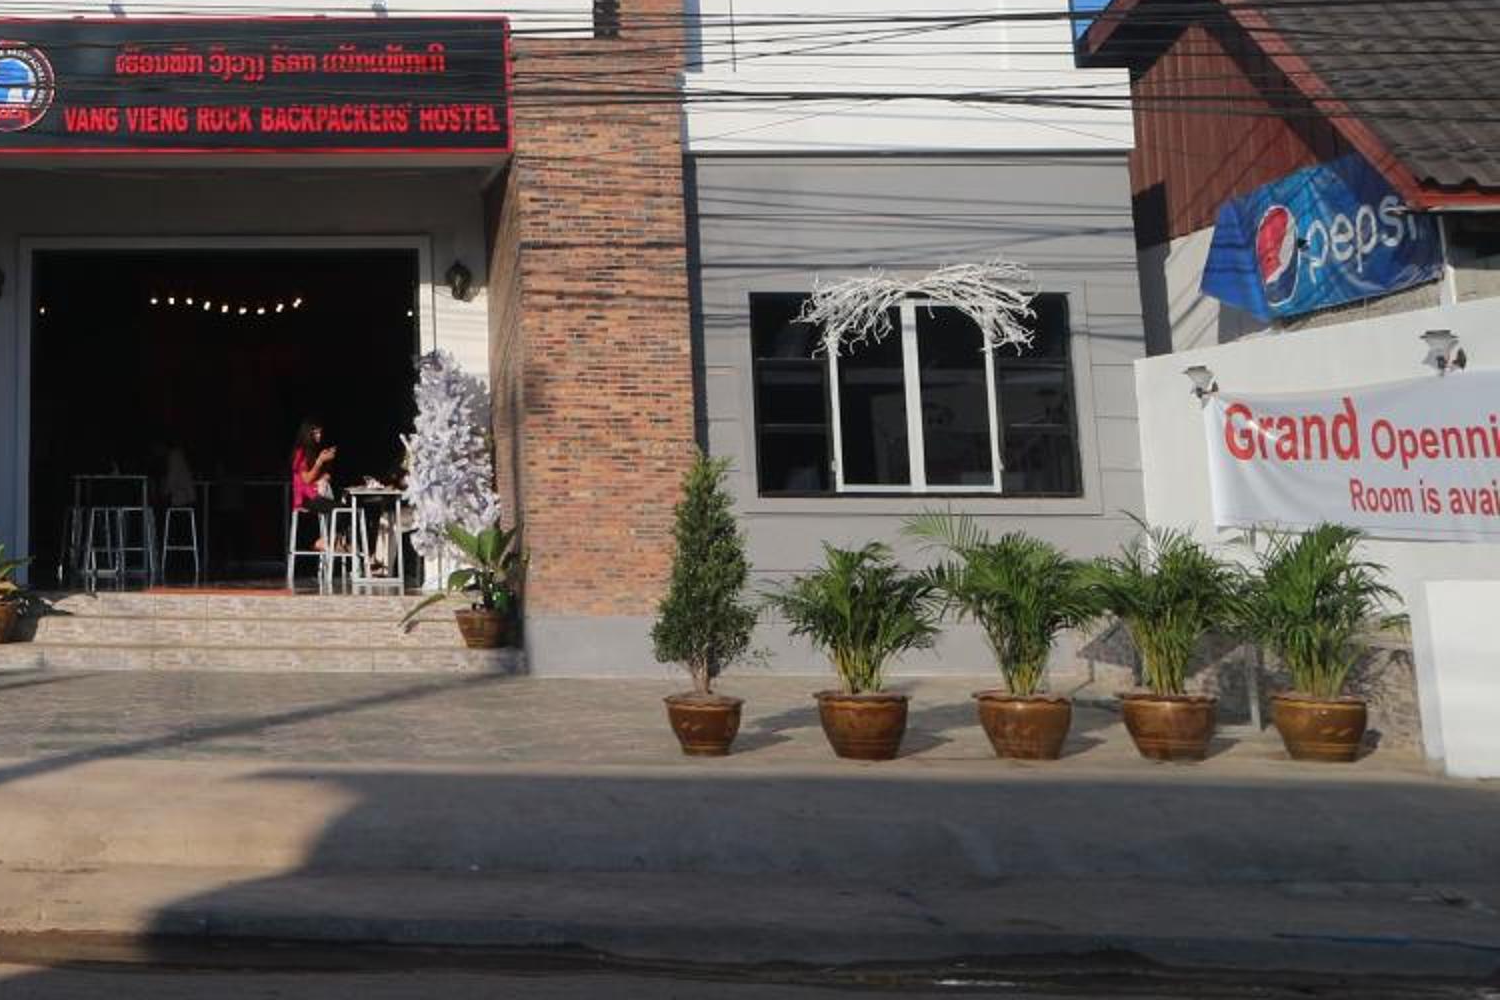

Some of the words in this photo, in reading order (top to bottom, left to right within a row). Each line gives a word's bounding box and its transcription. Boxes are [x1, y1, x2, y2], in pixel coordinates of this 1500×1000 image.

[64, 104, 119, 132] VANG
[126, 104, 188, 132] VIENG
[195, 104, 252, 132] ROCK
[419, 104, 499, 132] HOSTEL
[1225, 397, 1361, 461] Grand
[1349, 478, 1414, 513] Room
[1419, 477, 1442, 515] is
